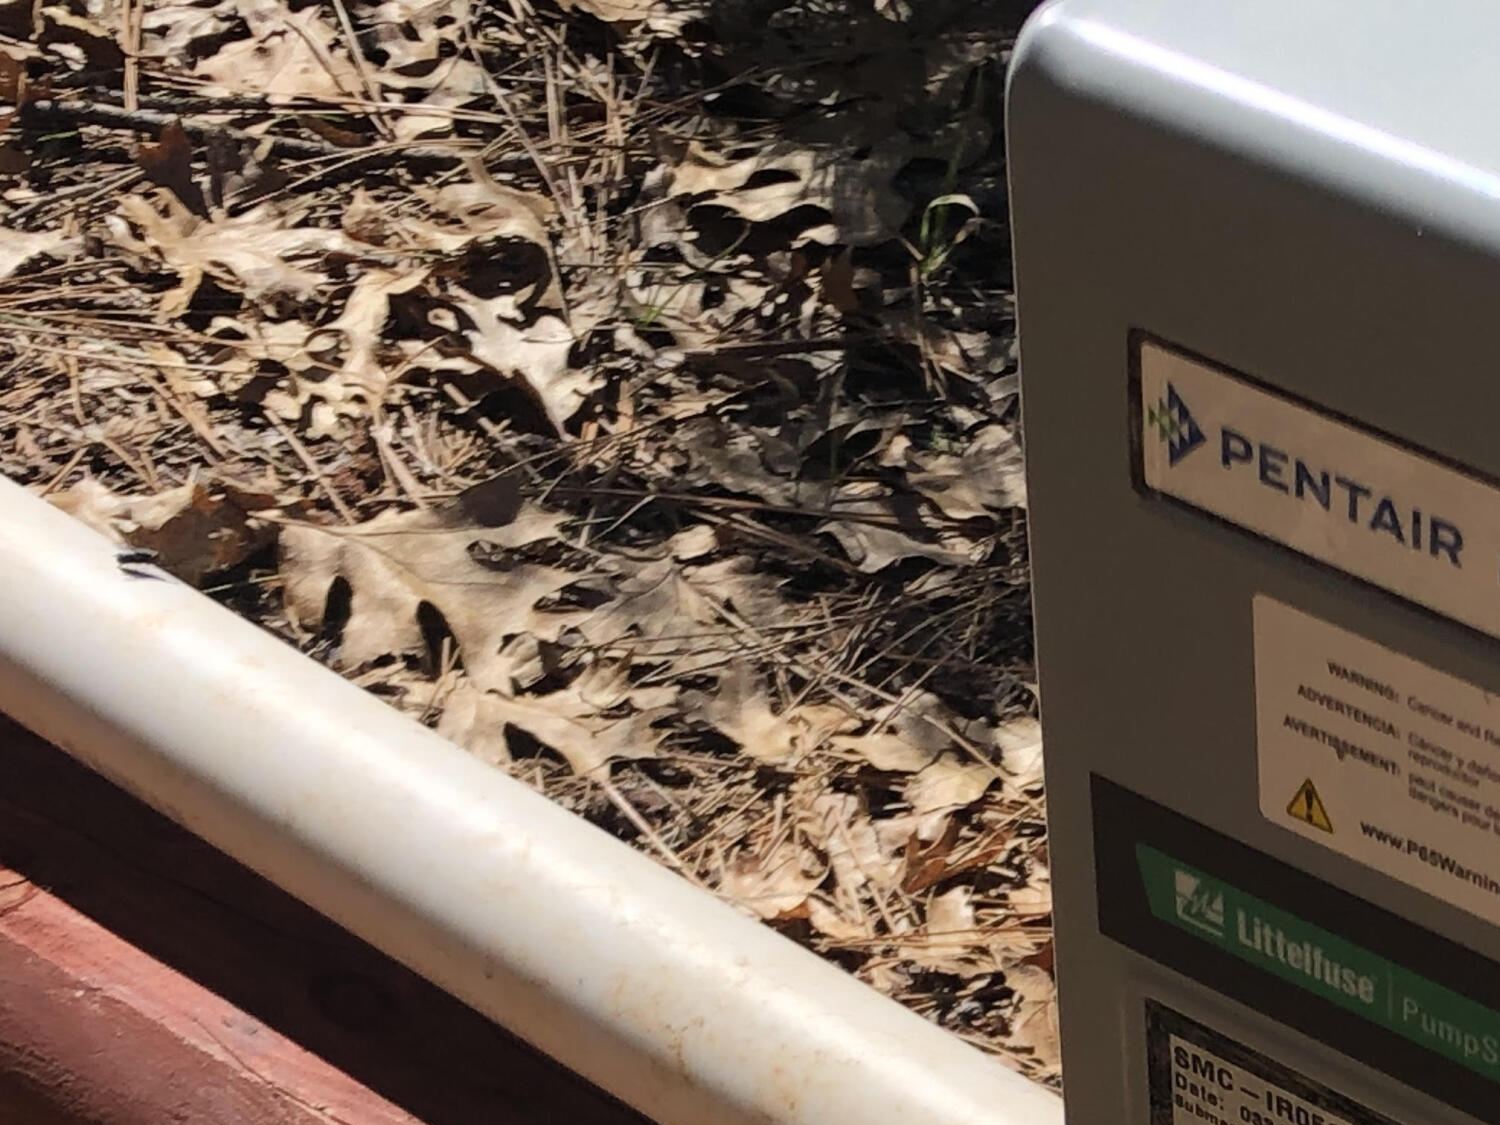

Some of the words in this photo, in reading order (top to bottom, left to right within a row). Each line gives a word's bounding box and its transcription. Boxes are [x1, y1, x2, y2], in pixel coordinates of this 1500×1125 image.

[1220, 426, 1465, 568] PENTAIR
[1237, 909, 1375, 1003] Littelfuse
[1175, 1072, 1224, 1110] Date:
